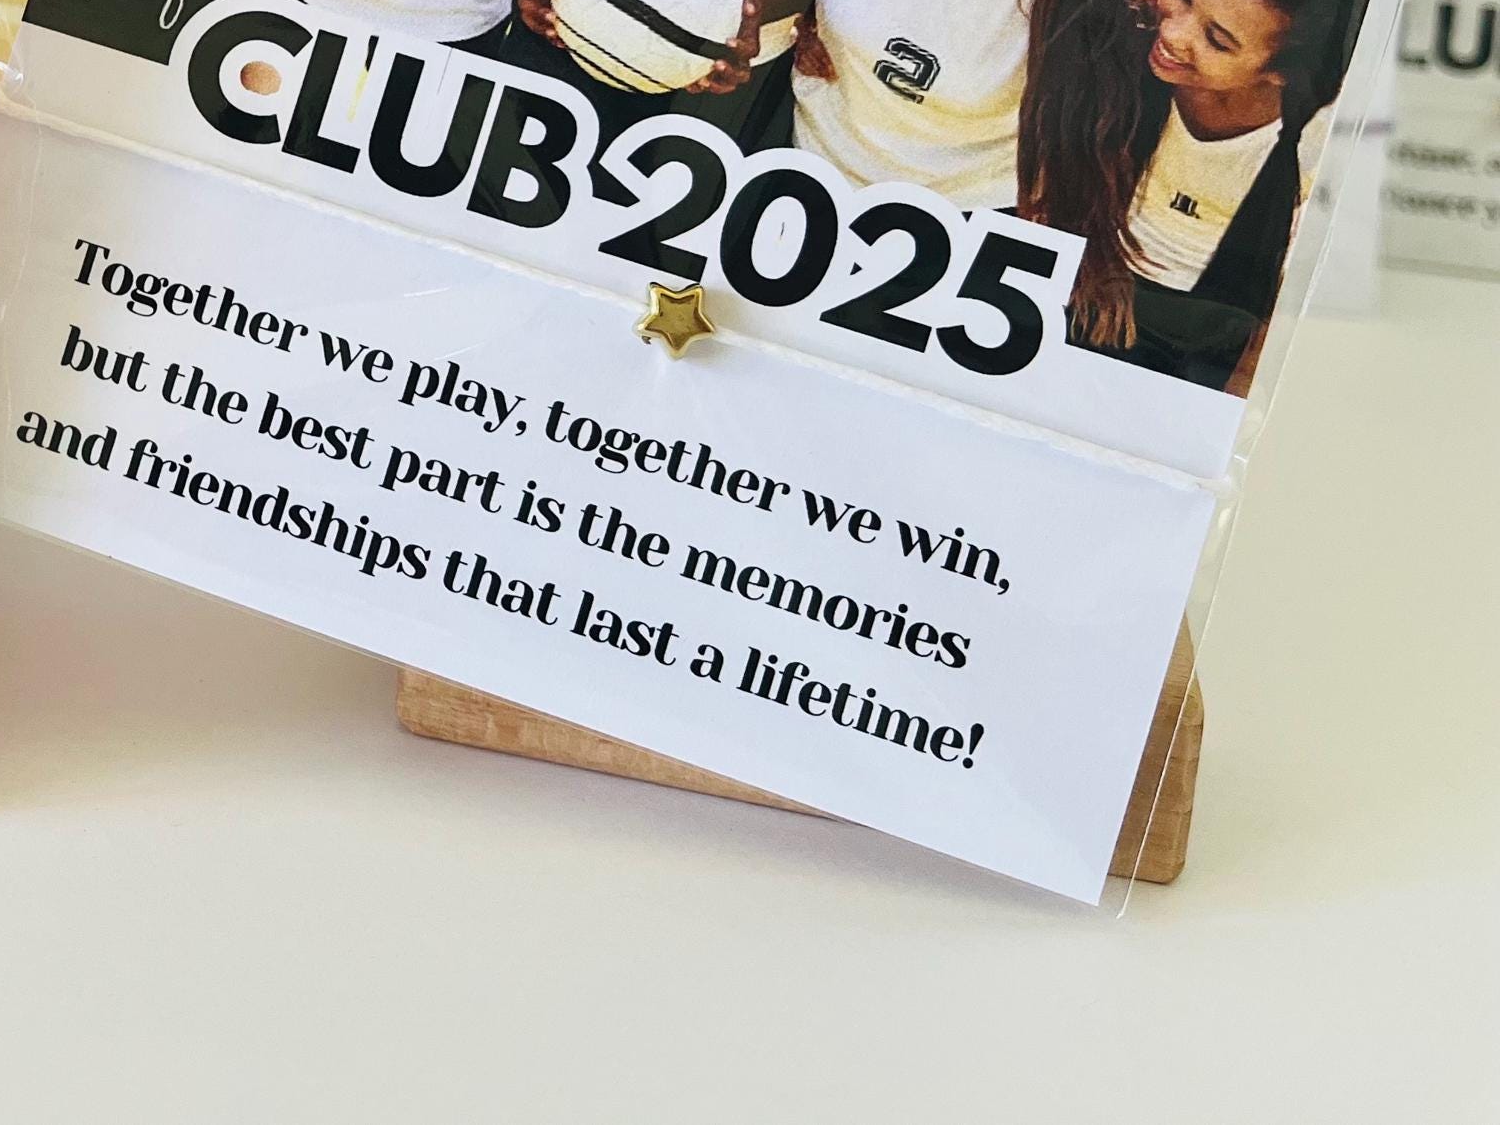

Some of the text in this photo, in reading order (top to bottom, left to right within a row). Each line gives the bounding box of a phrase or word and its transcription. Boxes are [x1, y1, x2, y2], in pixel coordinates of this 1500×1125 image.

[188, 10, 1059, 376] CLUB 2025
[16, 411, 985, 769] and friendships that last a lifetime!
[60, 324, 971, 669] but the best part is the memories
[74, 238, 1010, 596] Together we play, together we win,
